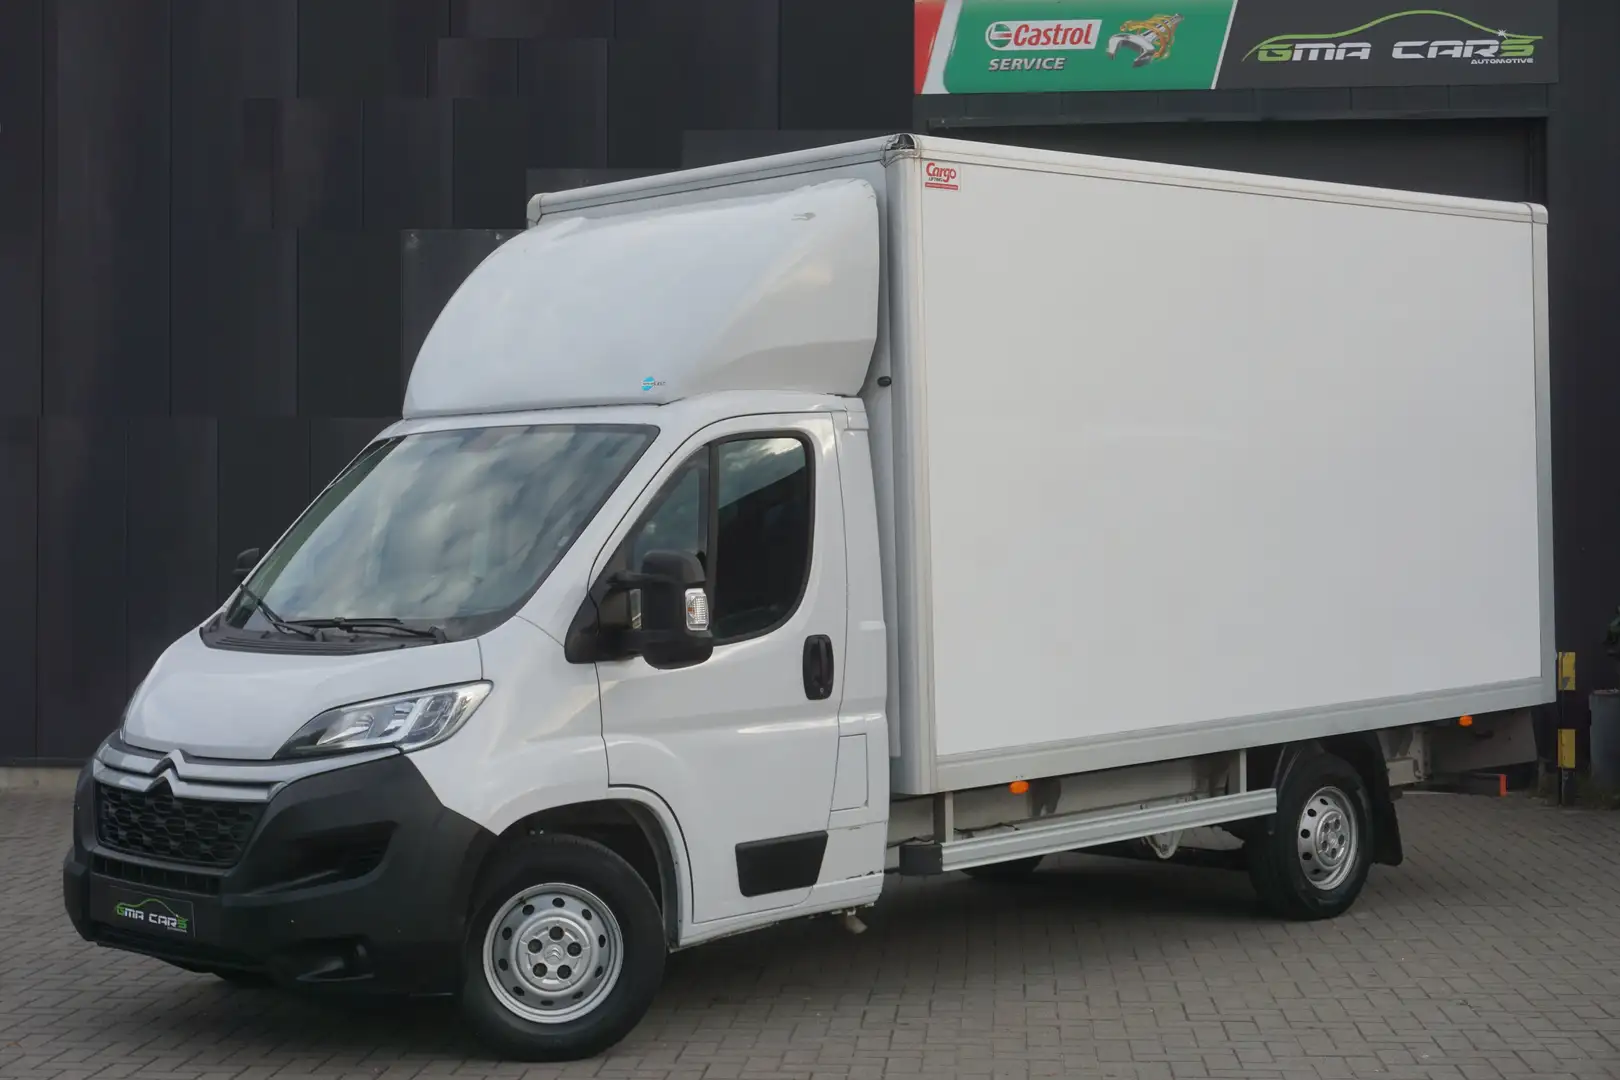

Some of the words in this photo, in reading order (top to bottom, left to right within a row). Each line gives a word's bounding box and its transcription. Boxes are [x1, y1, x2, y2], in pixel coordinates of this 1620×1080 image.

[1013, 23, 1093, 47] Castrol
[1257, 42, 1372, 62] GMA
[1391, 38, 1536, 59] CARS
[988, 57, 1066, 71] SERVICE
[1470, 57, 1534, 65] AUTOMOTIVE
[926, 162, 956, 182] Cargo
[116, 906, 144, 920] GMA
[148, 913, 188, 929] CARS
